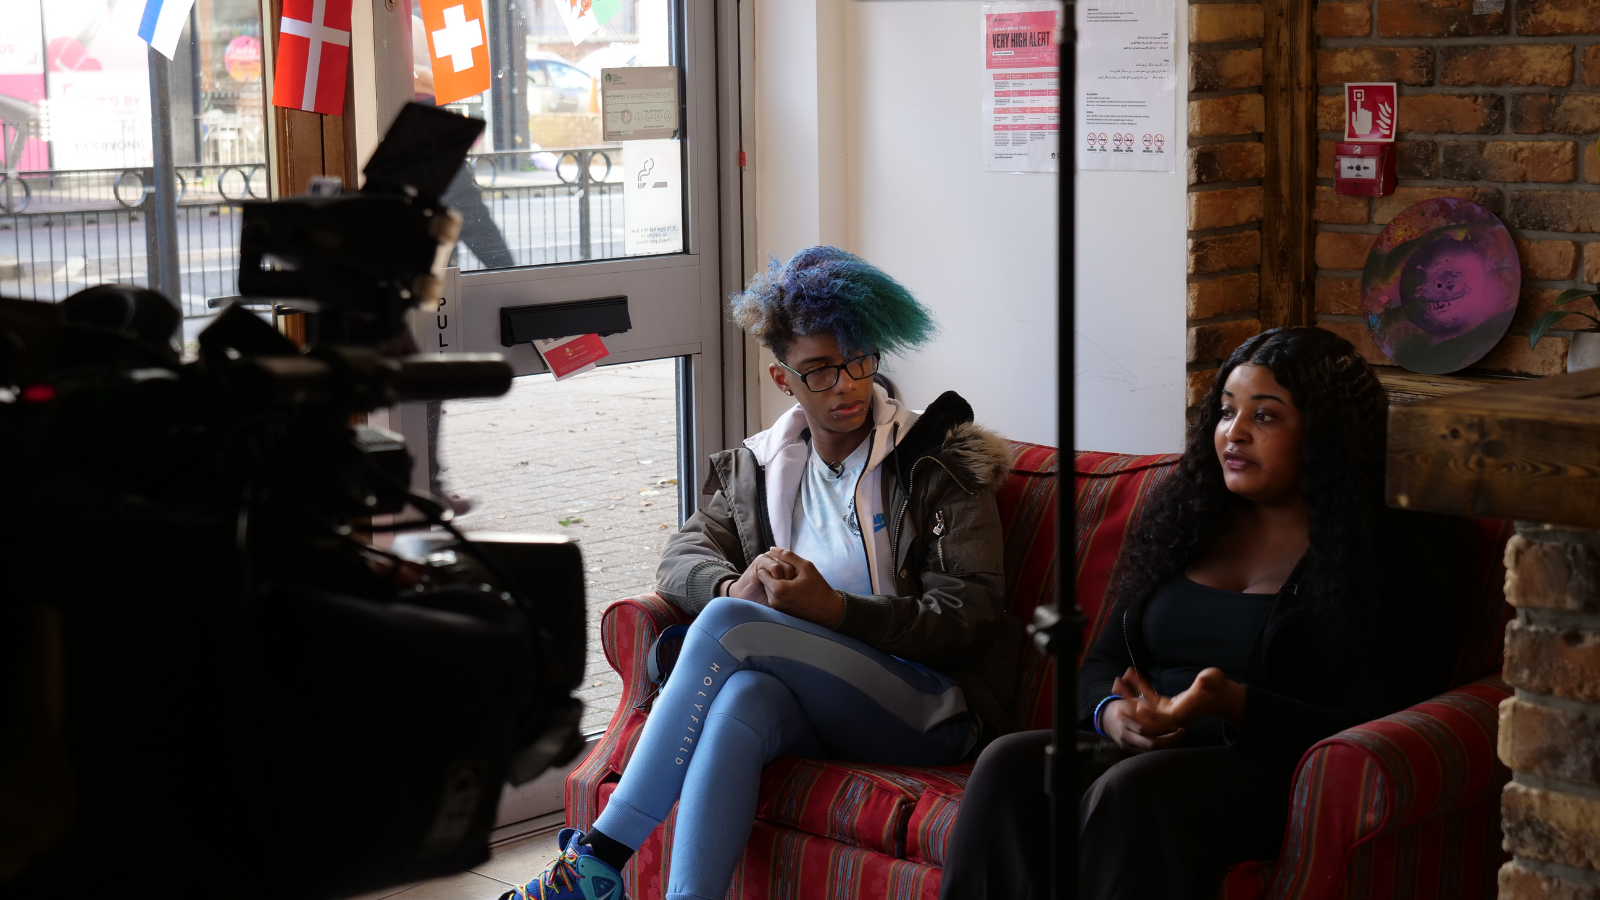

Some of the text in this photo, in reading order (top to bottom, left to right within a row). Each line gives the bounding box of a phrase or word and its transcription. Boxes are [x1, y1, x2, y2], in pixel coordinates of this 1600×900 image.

[992, 31, 1050, 49] VERY HIGH ALERT
[437, 297, 448, 354] PUL
[873, 513, 886, 525] NIK
[675, 662, 720, 765] HOLYFIELD
